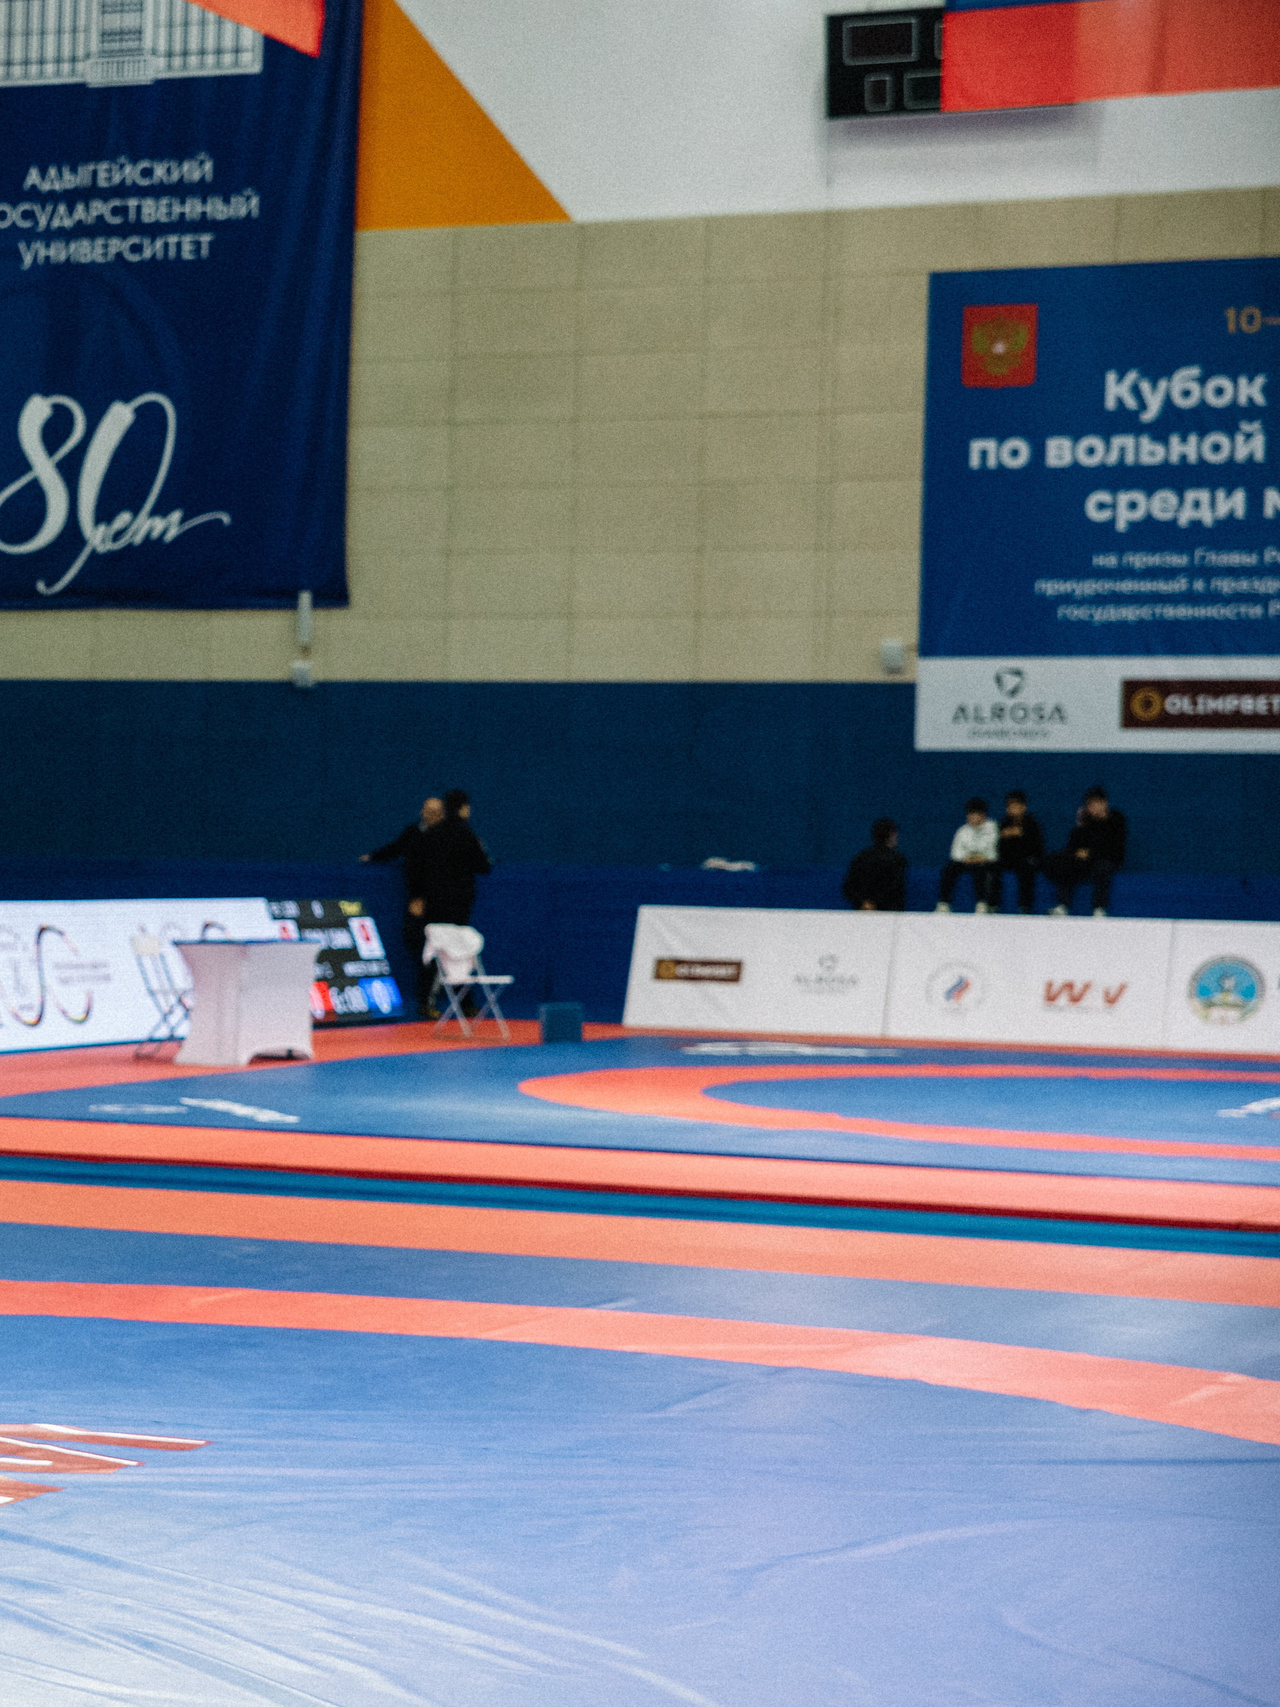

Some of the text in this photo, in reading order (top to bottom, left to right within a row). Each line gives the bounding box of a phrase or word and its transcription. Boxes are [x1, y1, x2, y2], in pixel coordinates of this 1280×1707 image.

[23, 152, 215, 193] АДЫГЕЙСКИЙ
[19, 232, 215, 271] УНИВЕРСИТЕТ
[1104, 365, 1269, 424] Кубок
[968, 420, 1267, 470] по вольной
[1084, 486, 1247, 533] среди
[1092, 553, 1118, 569] на
[951, 702, 1068, 726] ALROSA
